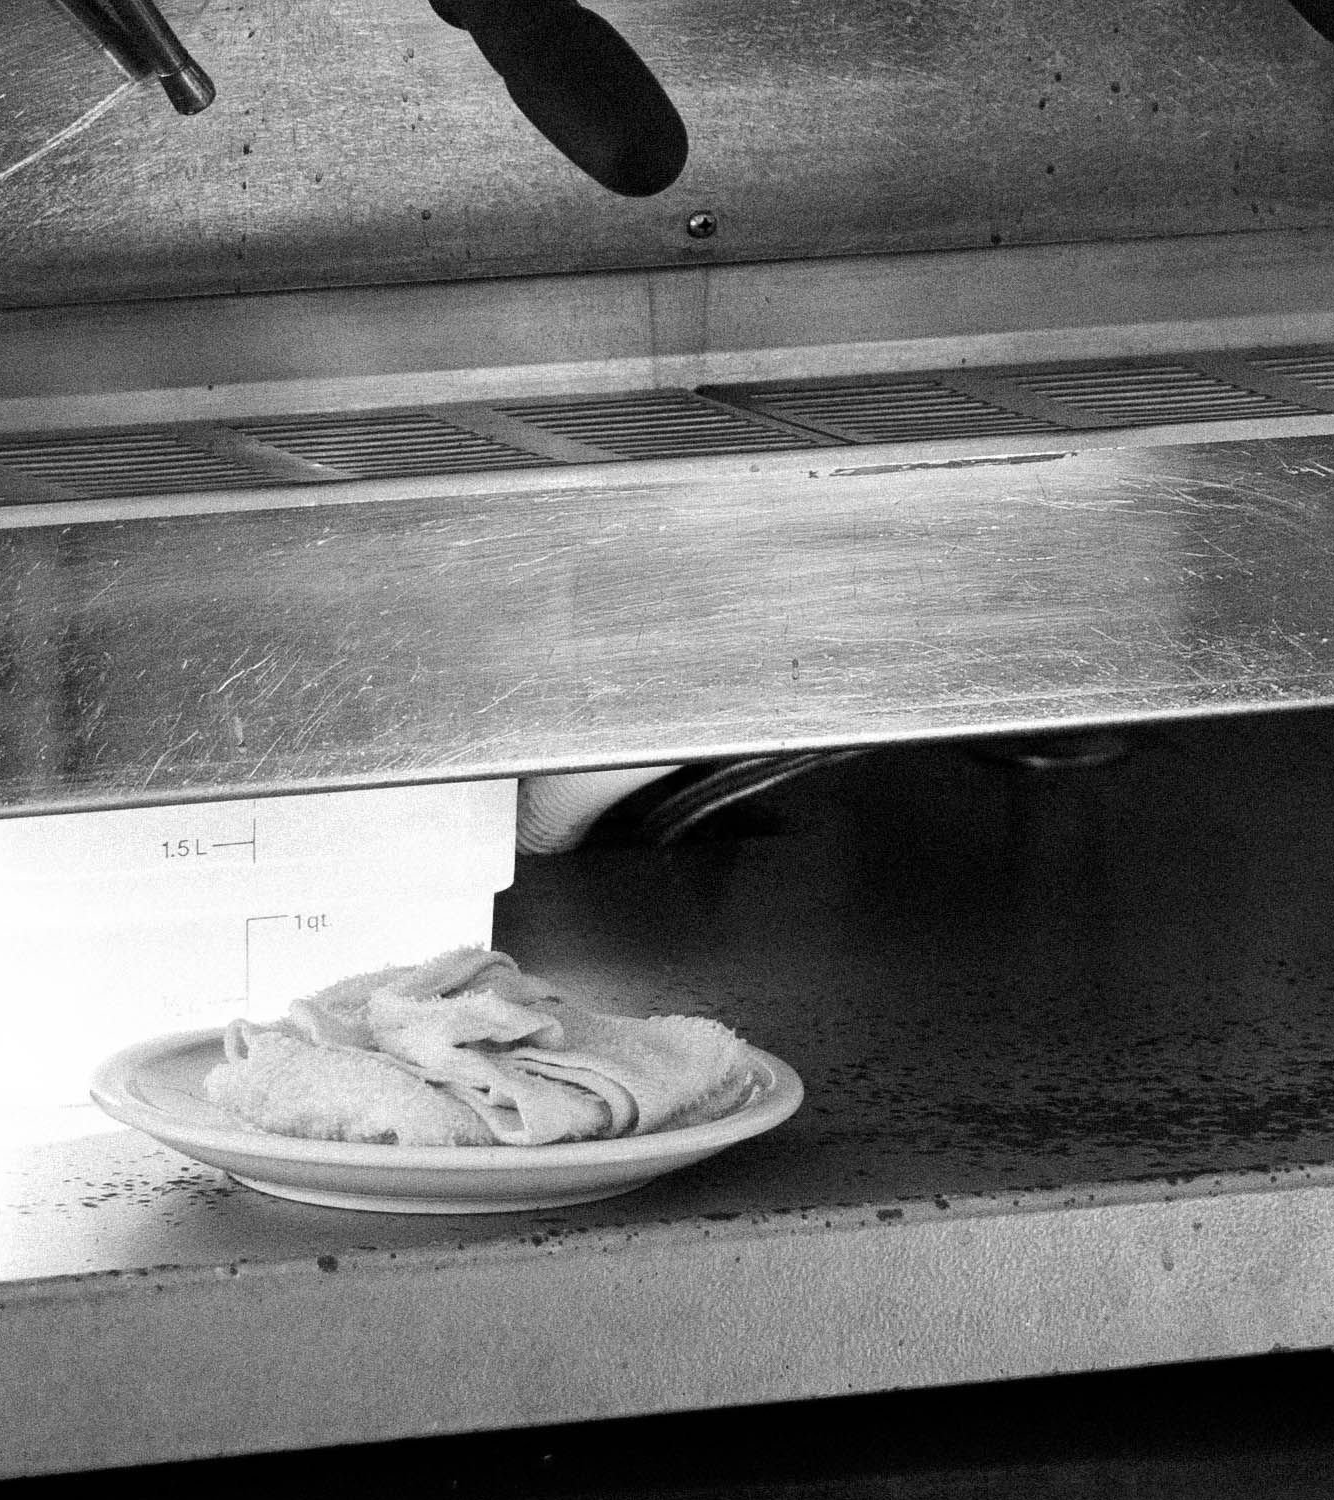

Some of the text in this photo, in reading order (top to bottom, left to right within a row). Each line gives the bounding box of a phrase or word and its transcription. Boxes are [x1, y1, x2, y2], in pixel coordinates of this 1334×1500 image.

[162, 838, 208, 859] 1.5 L
[294, 913, 302, 930] 1
